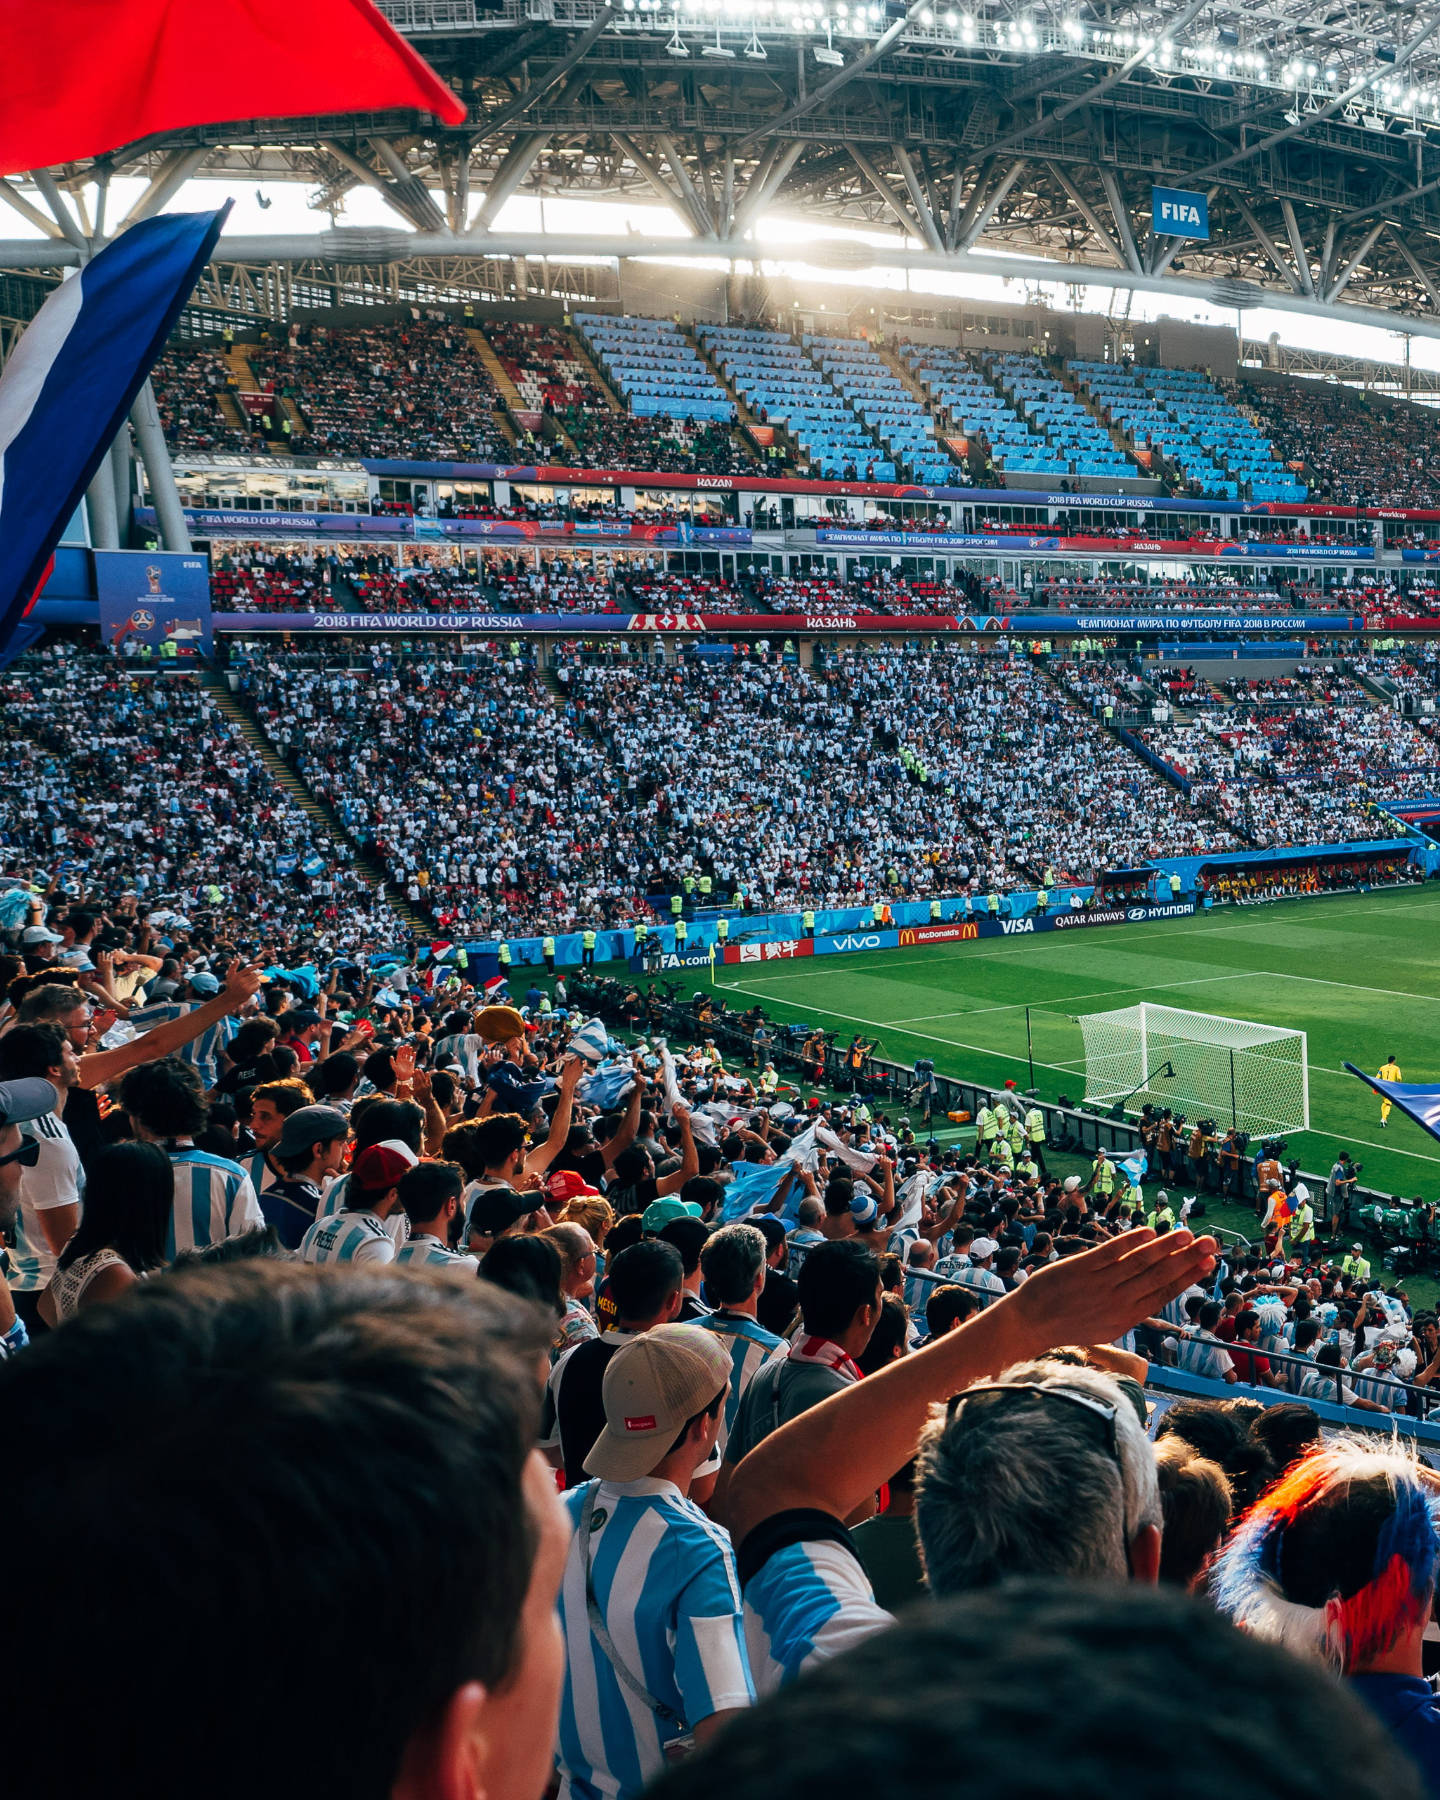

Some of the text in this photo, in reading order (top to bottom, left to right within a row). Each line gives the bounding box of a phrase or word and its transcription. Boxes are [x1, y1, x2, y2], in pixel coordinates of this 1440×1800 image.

[1162, 202, 1201, 225] FIFA
[697, 478, 733, 488] KAZAN
[1048, 496, 1064, 504] 2018
[1065, 496, 1081, 505] FIFA
[1082, 497, 1109, 506] WORLD
[1127, 499, 1154, 508] RUSSIA
[222, 516, 259, 525] WORLD
[260, 517, 280, 525] CUP
[281, 518, 316, 526] RUSSIA
[314, 616, 523, 627] 2018 FIFA WORLD CUP RUSSIA
[806, 617, 857, 628] КАЗАНЬ
[1077, 619, 1135, 628] ЧЕМПИОНАТ
[1138, 619, 1164, 628] МИРА
[1166, 619, 1179, 628] ПО
[1181, 619, 1221, 628] ФУТБОЛУ
[1224, 619, 1242, 628] FIFA
[1243, 619, 1262, 628] 2018
[1271, 619, 1305, 628] РОССИИ
[1148, 904, 1194, 918] HYUNDAI
[1055, 911, 1125, 928] QATAR AIRWAYS
[999, 918, 1035, 934] VISA
[918, 929, 960, 939] McDonald's
[642, 954, 711, 970] FFA.com
[597, 1295, 618, 1317] MESSI
